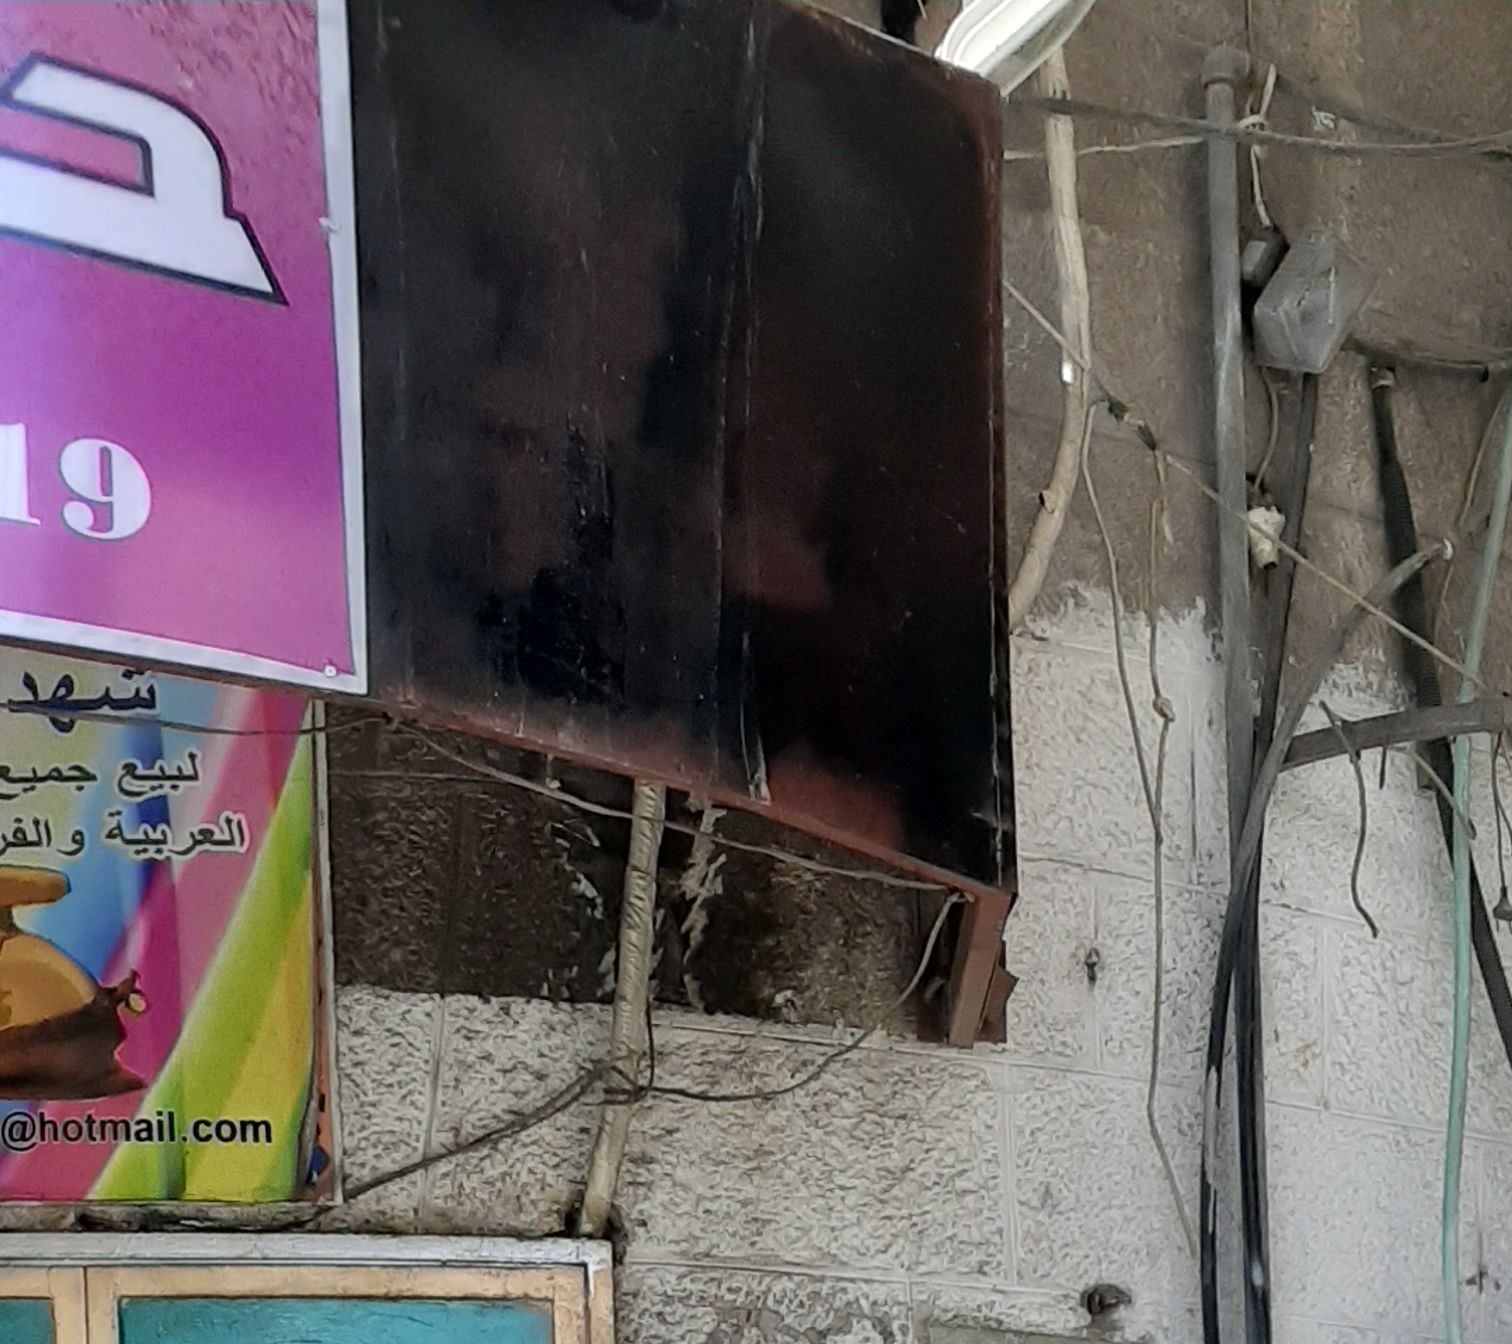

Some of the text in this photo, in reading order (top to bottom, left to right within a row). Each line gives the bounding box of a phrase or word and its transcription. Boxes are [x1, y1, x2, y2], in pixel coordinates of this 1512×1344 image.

[117, 751, 199, 797] لبيع
[105, 809, 245, 856] العربية
[1, 1110, 273, 1152] @hotmail.com
